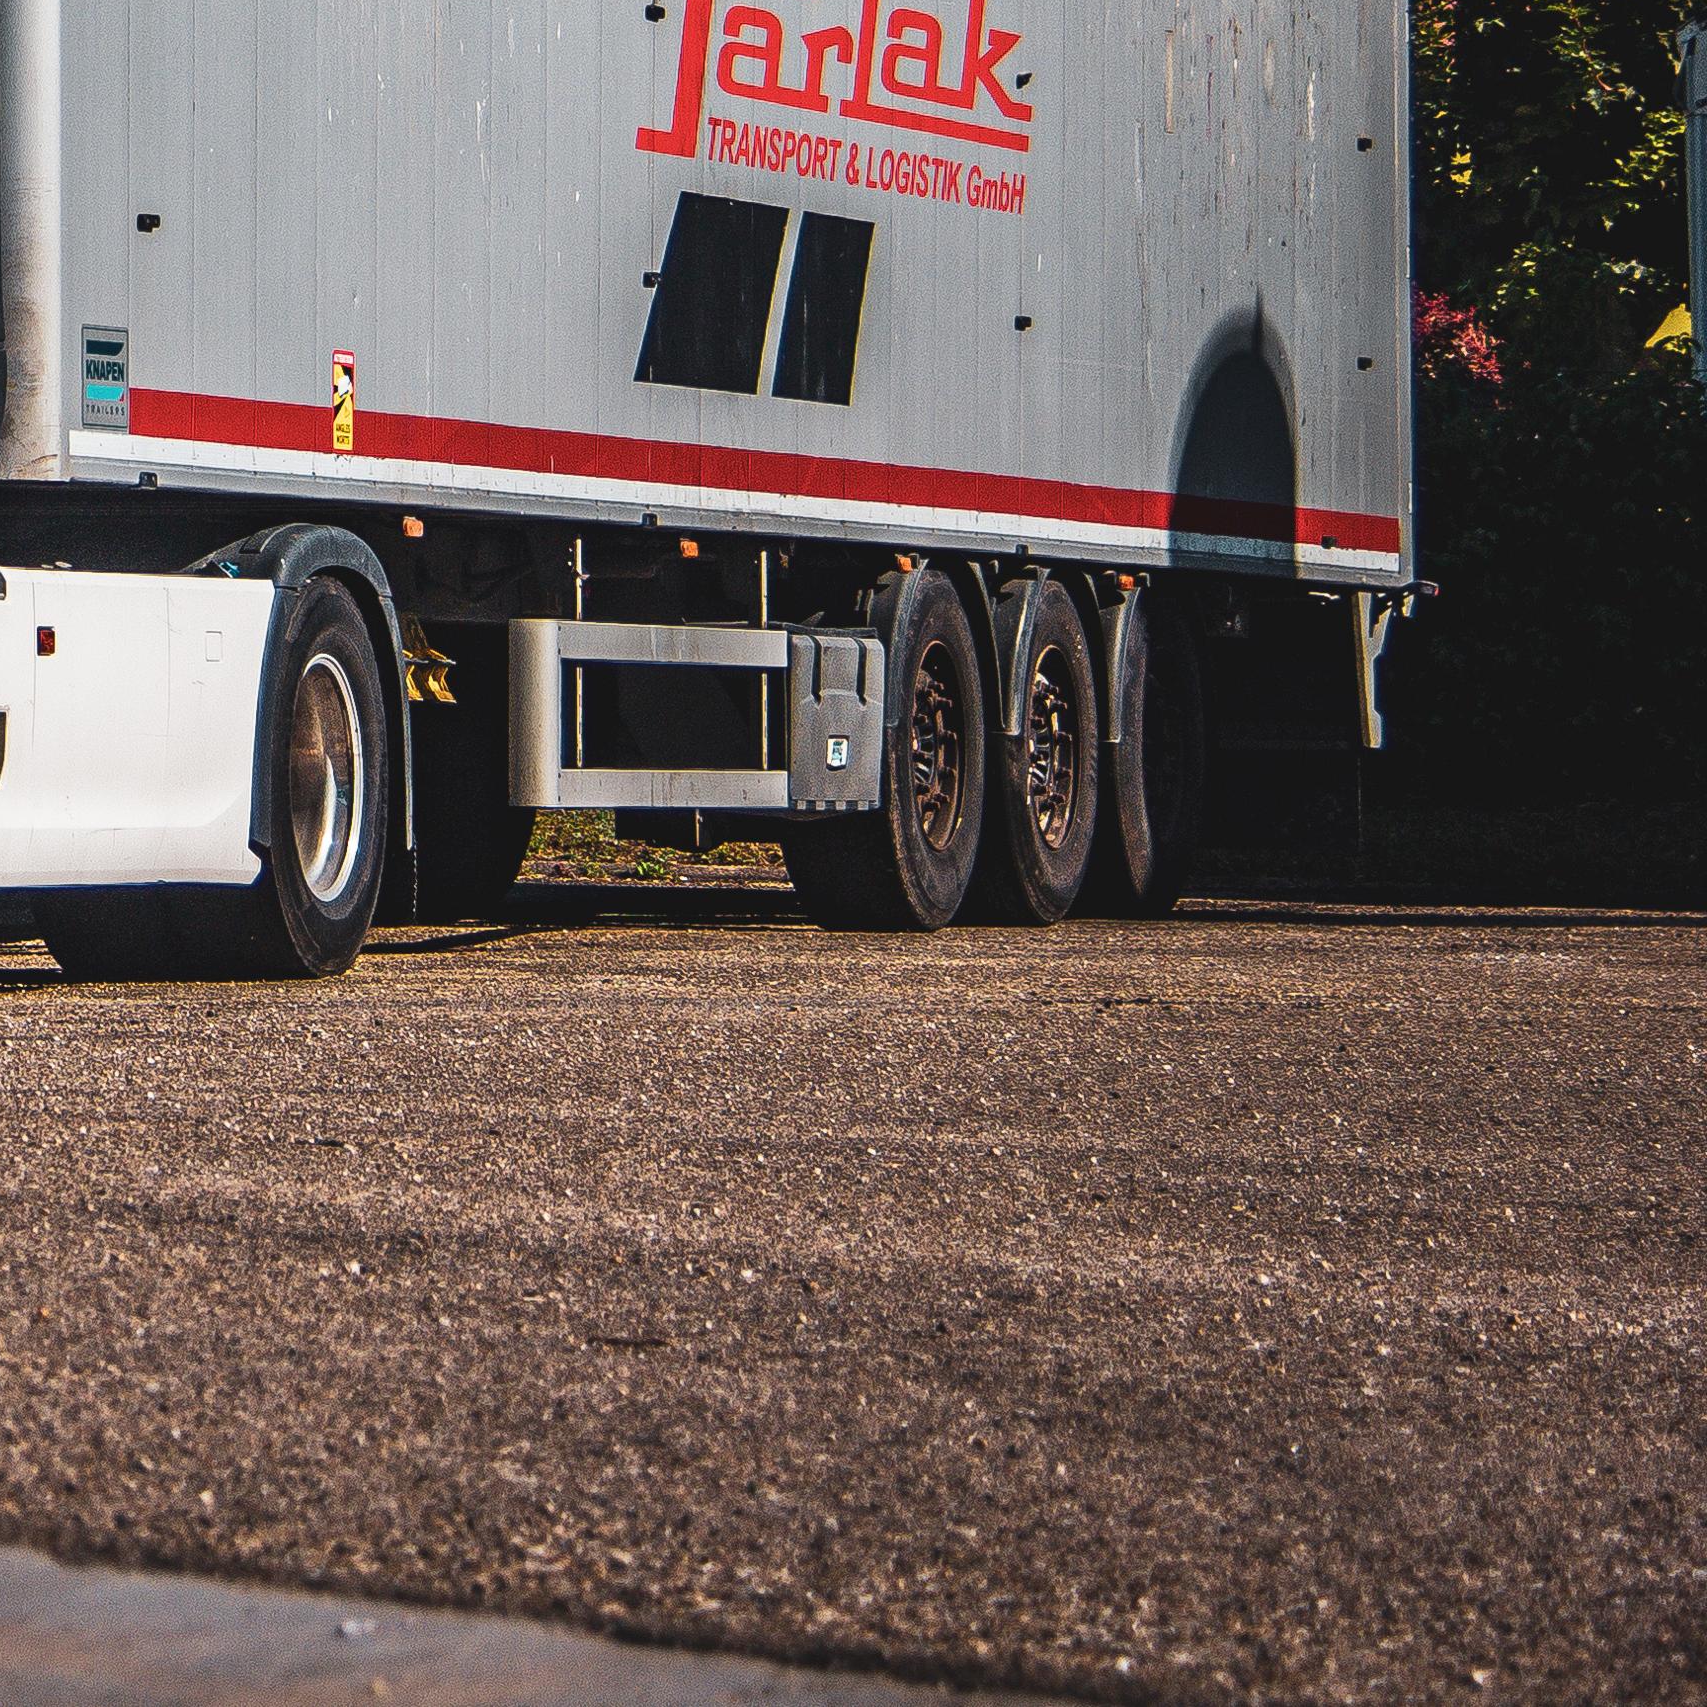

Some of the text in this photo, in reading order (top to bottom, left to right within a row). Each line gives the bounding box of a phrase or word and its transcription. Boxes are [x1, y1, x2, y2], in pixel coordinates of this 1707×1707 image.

[707, 116, 1026, 214] TRANSPORT & LOGISTIK GmbH
[85, 359, 125, 383] KNAPEN
[85, 404, 125, 416] TRAILERS
